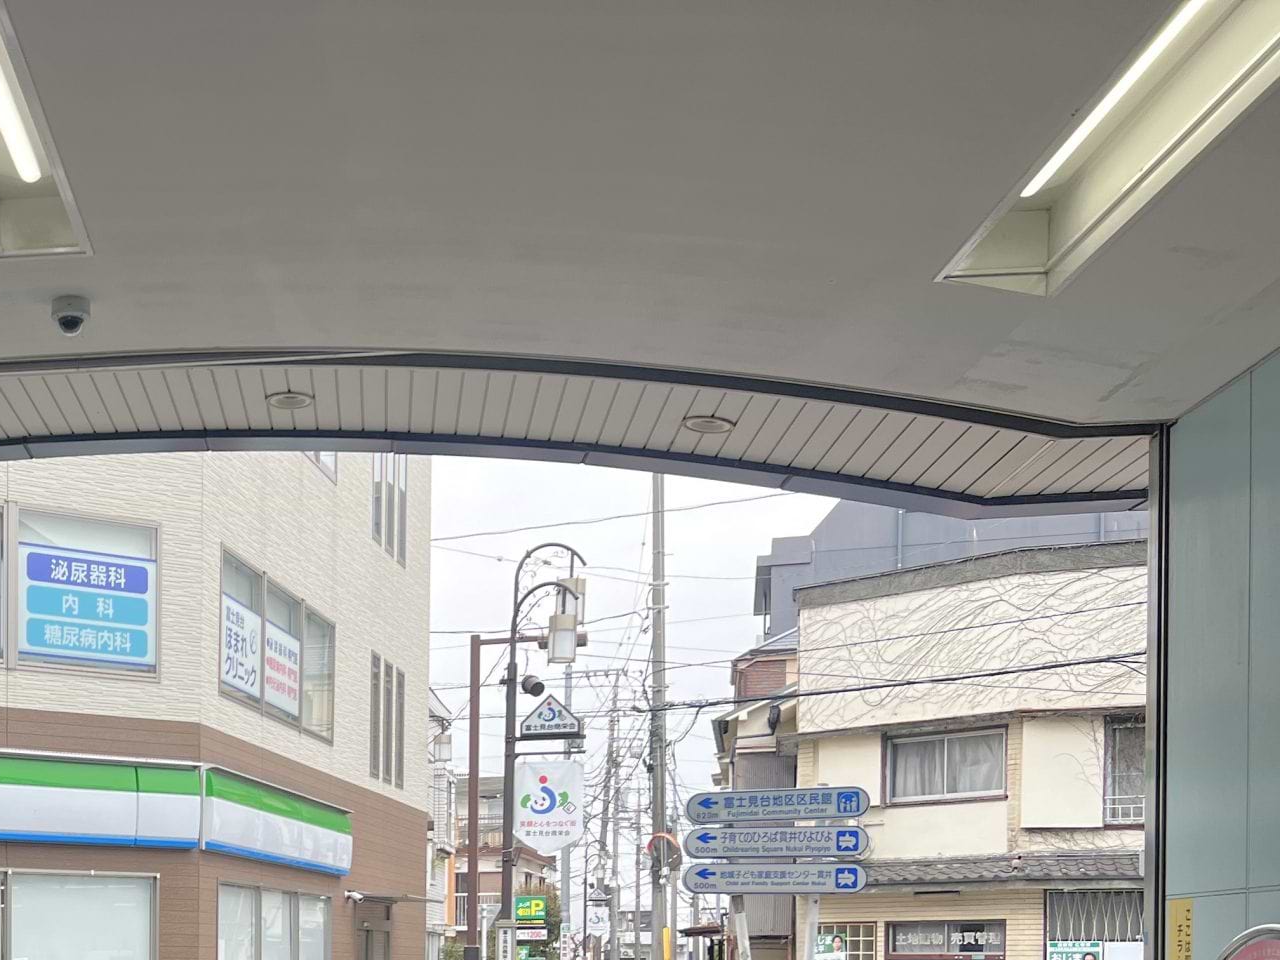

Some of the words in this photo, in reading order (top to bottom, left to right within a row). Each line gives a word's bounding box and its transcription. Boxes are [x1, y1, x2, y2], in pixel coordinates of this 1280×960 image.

[50, 558, 126, 588] 泌尿器科
[43, 623, 131, 652] 糖尿病内科
[225, 625, 248, 658] ほまれ
[225, 653, 257, 688] クリニック
[724, 793, 832, 809] 富士見台地区区民館
[728, 810, 759, 818] Fujimidai
[761, 806, 801, 816] Community
[804, 806, 827, 814] Center
[531, 900, 544, 916] P
